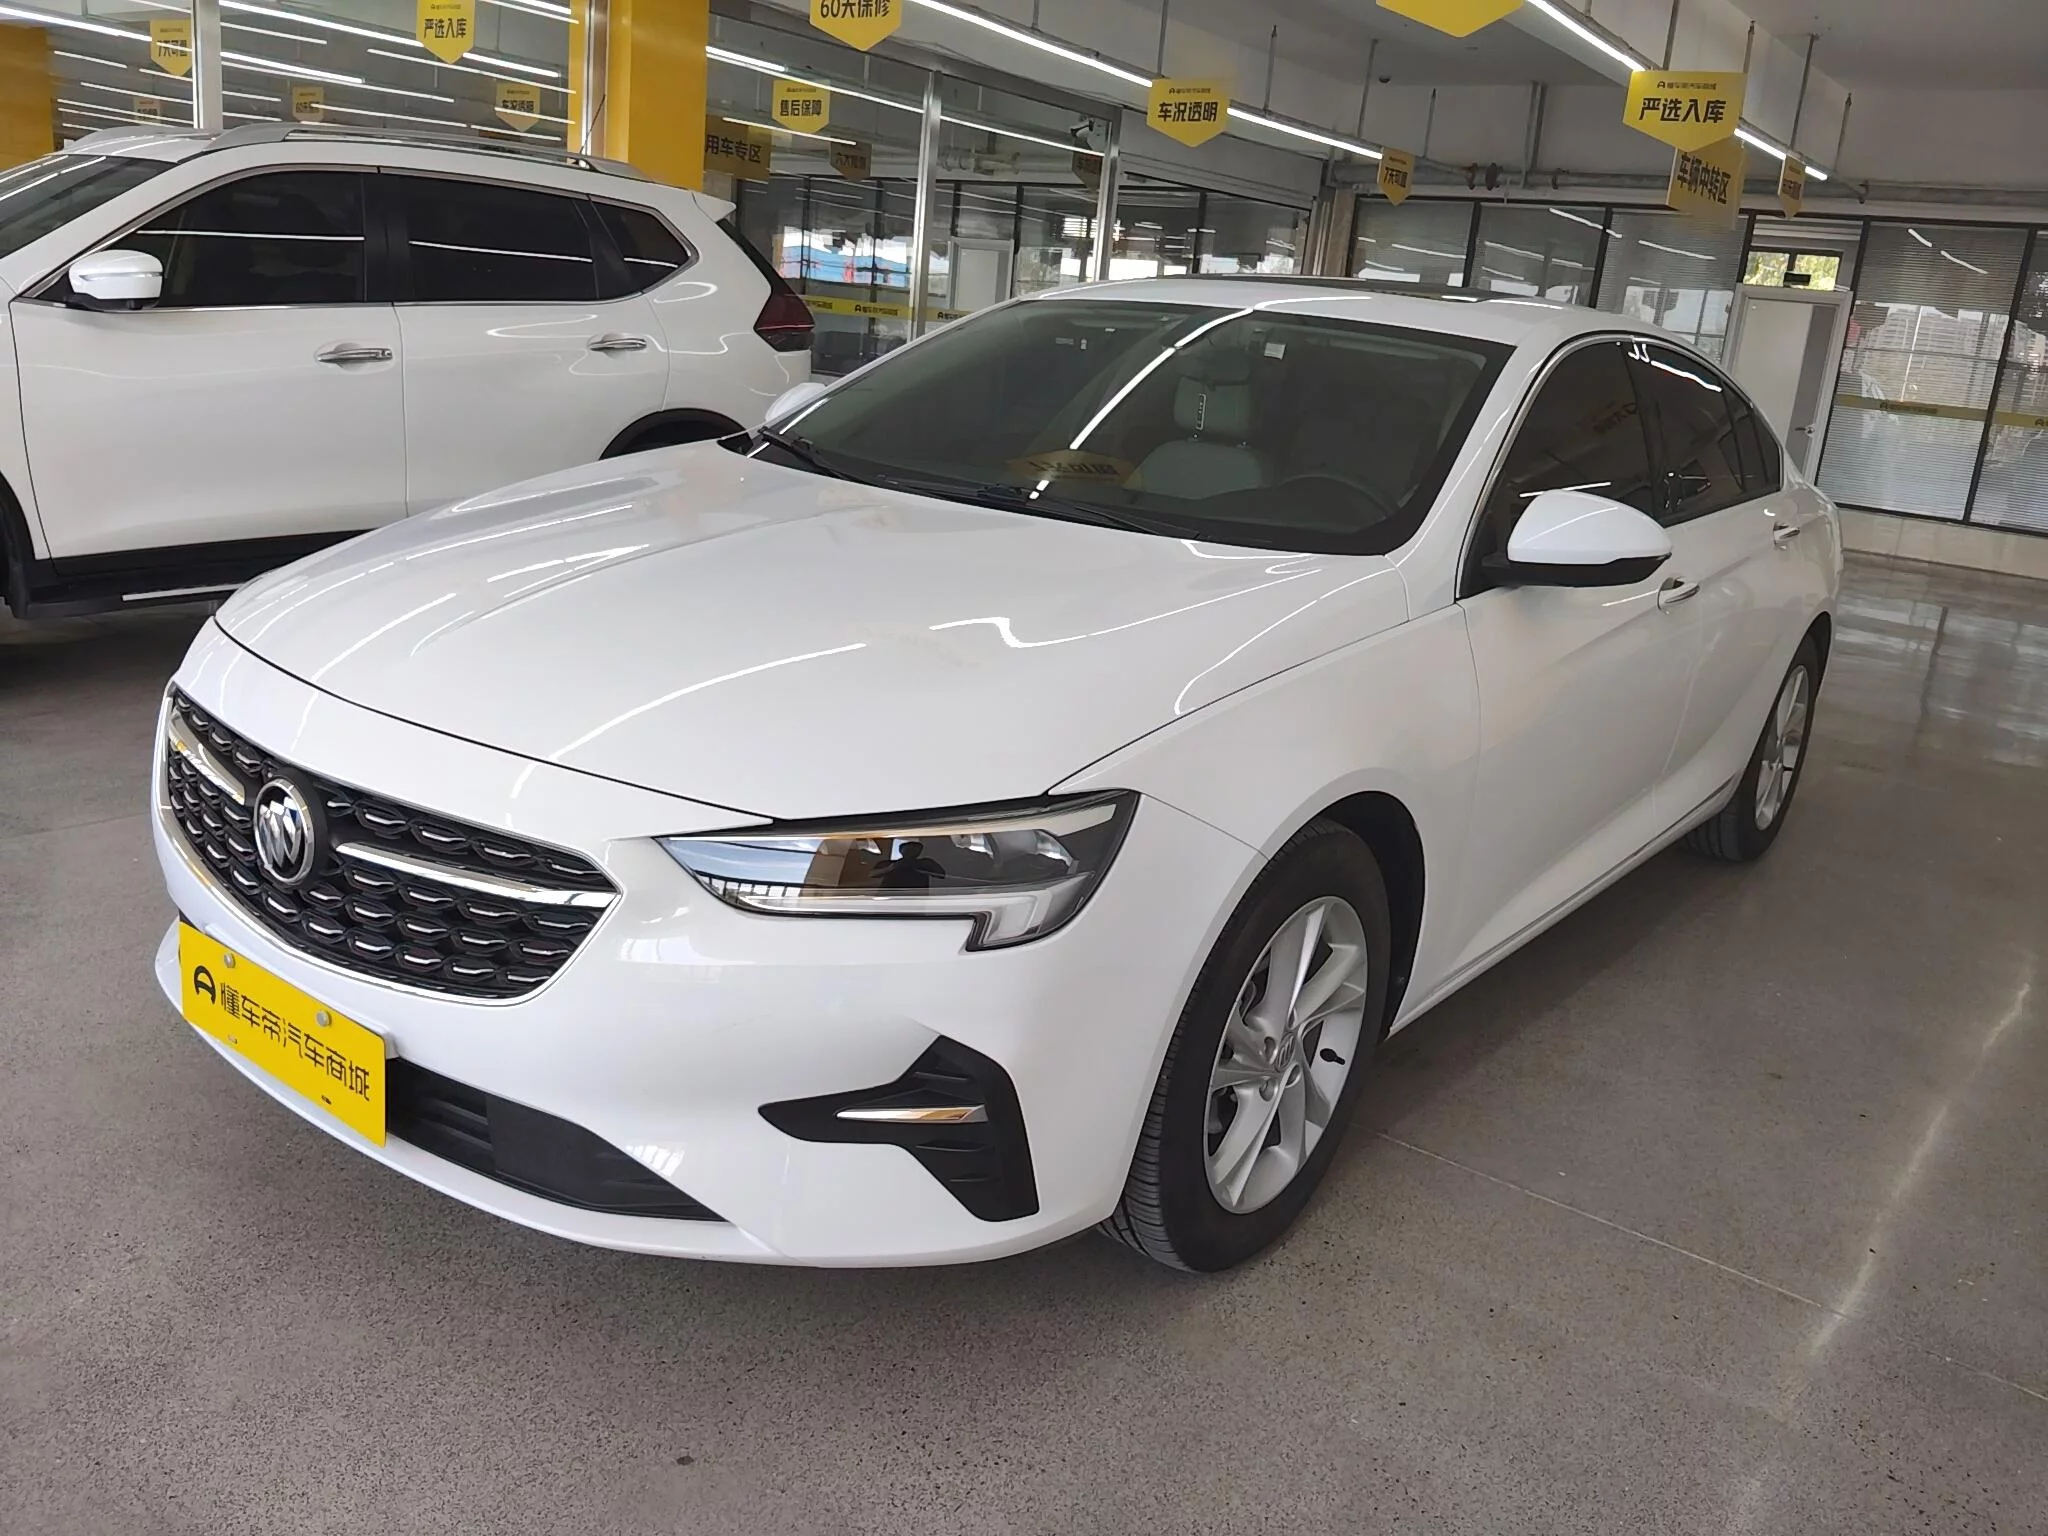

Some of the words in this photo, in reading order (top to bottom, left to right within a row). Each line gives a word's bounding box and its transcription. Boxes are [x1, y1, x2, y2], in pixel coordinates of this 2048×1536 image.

[820, 0, 891, 18] 60天保修
[423, 18, 467, 38] 严选入库
[157, 40, 188, 57] 7天可
[780, 100, 823, 116] 售后保障
[1158, 101, 1218, 122] 车况透明
[1639, 97, 1726, 123] 严选入库
[1384, 166, 1408, 188] 7天可
[1677, 152, 1731, 204] 车辆中转区
[220, 982, 371, 1101] 懂车帝汽车商城
